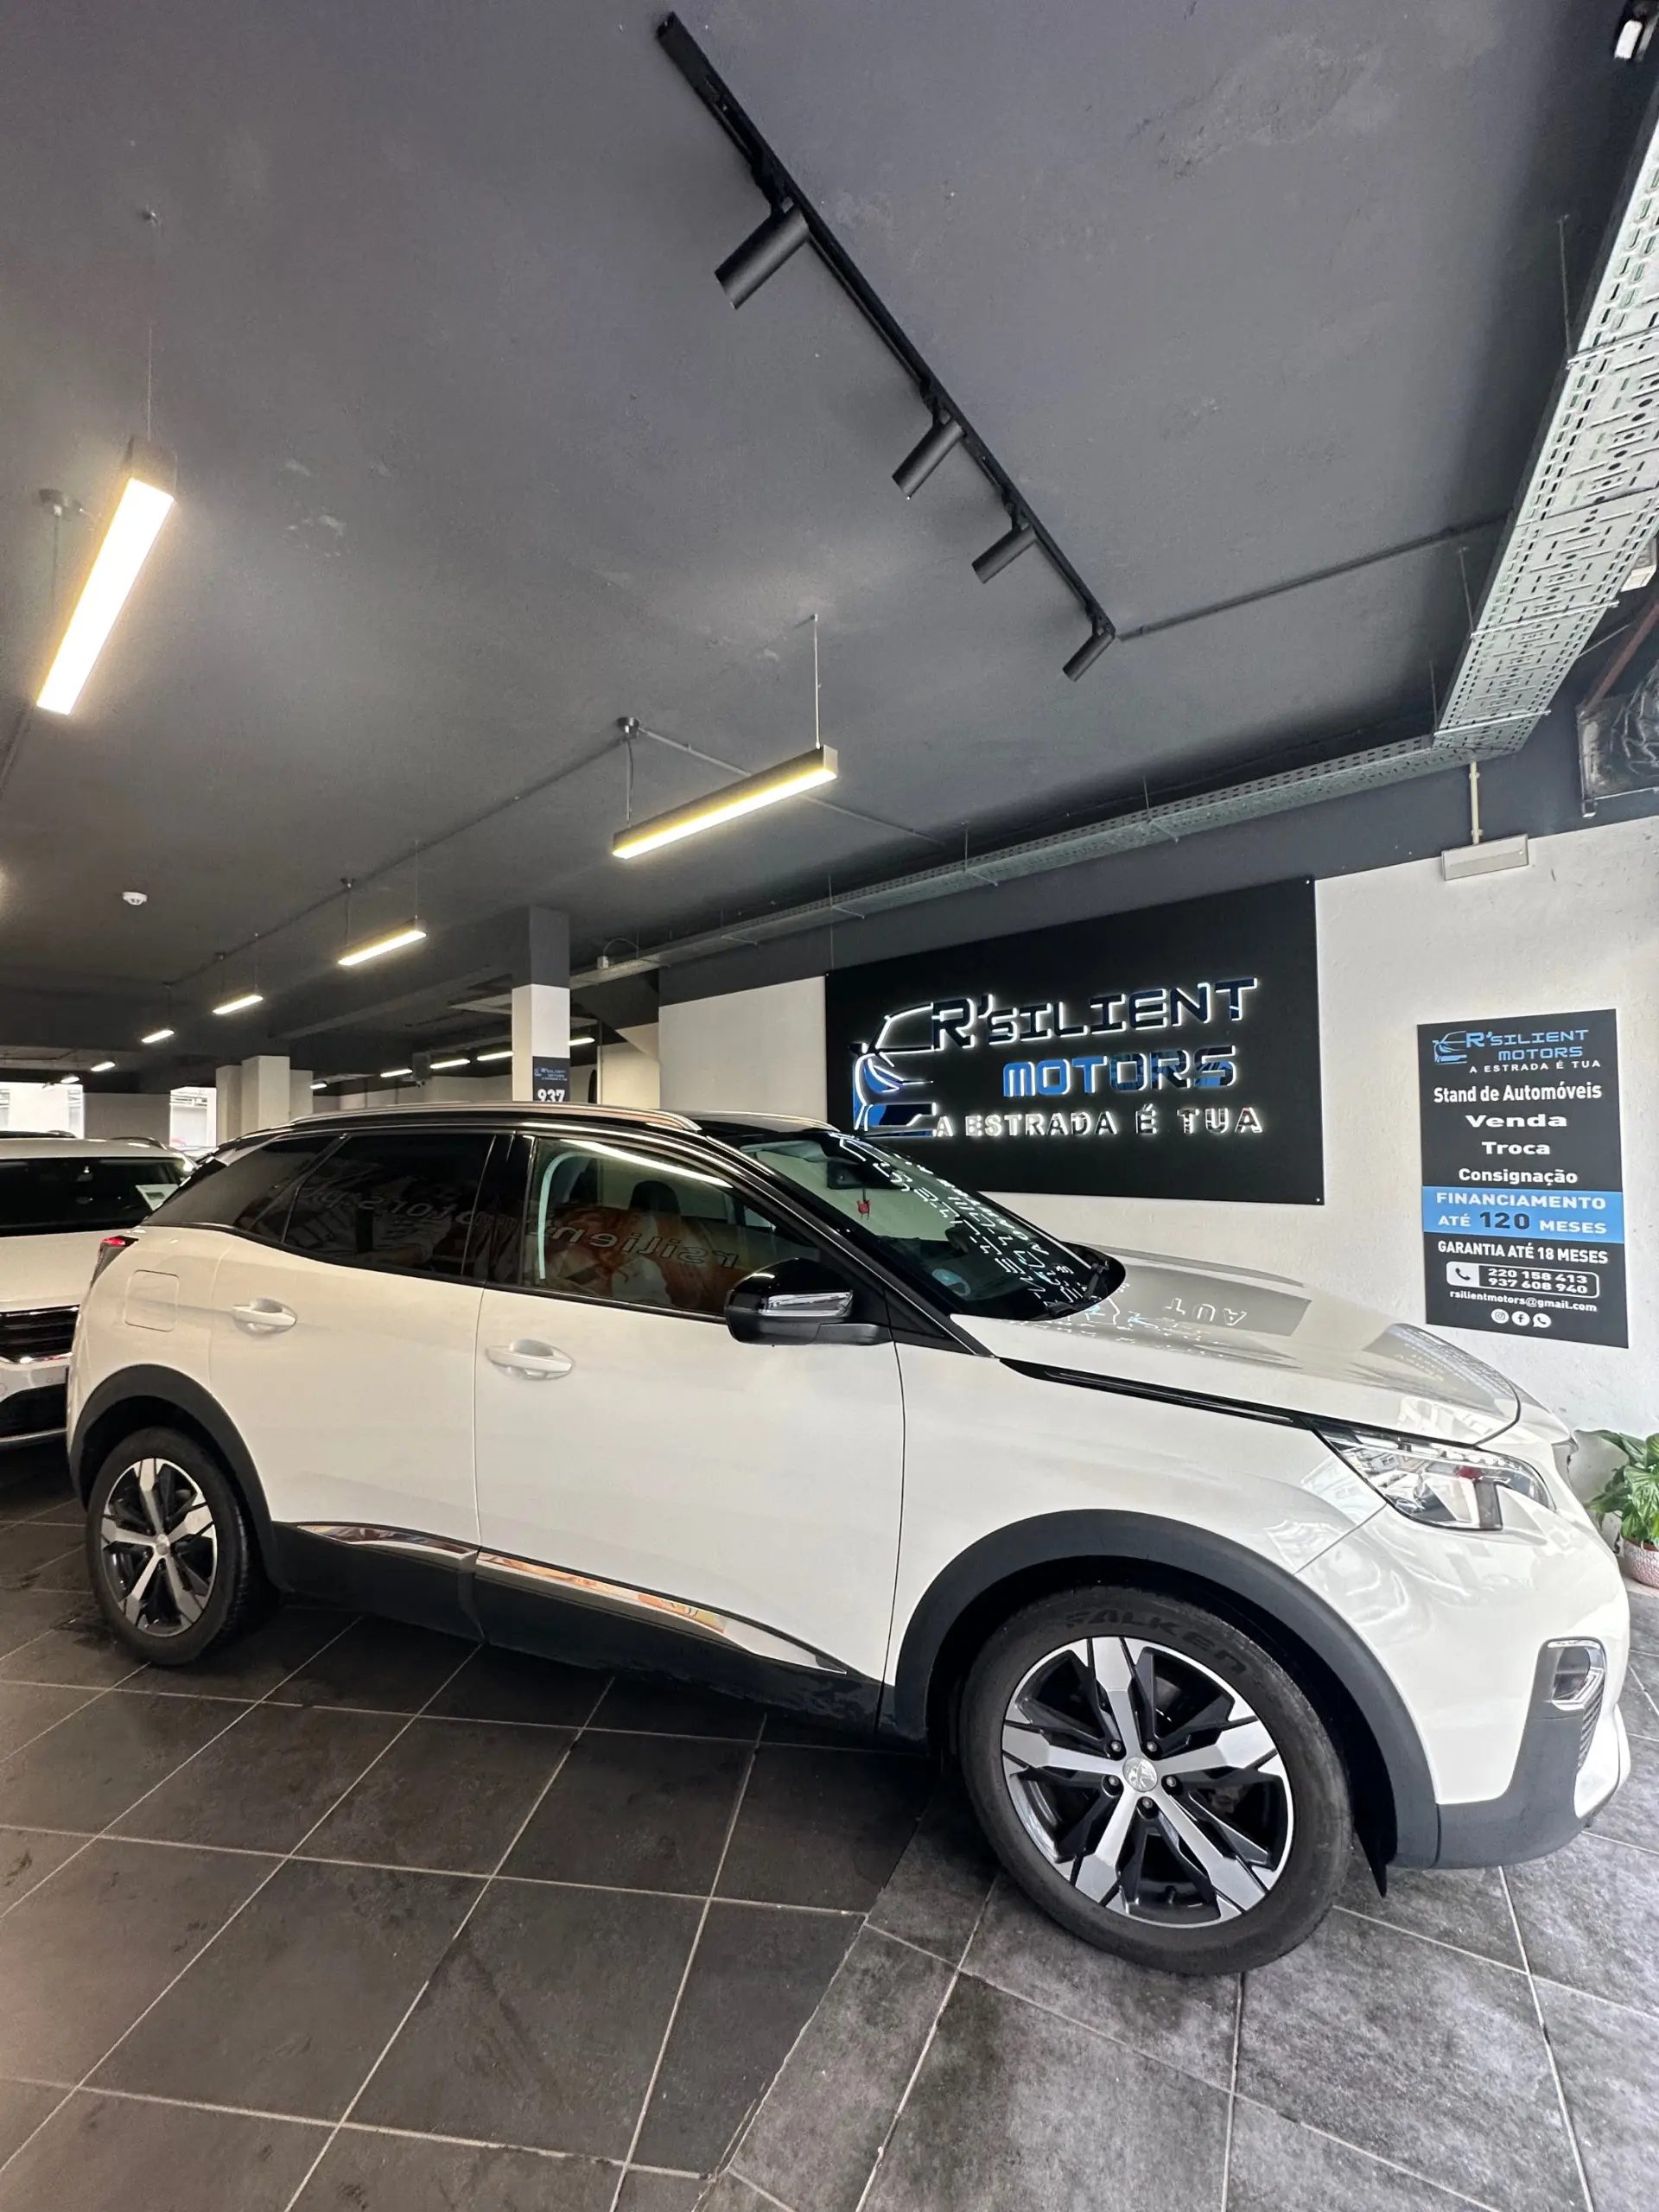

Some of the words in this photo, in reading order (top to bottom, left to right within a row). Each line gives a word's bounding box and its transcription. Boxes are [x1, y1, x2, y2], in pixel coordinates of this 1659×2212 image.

[1498, 1046, 1583, 1061] MOTORS
[1002, 1046, 1236, 1097] MOTORS
[1484, 1063, 1548, 1072] ESTRADA
[1556, 1060, 1564, 1070] É
[1433, 1085, 1477, 1103] Stand
[1480, 1086, 1499, 1102] de
[1503, 1082, 1602, 1101] Automóveis
[933, 1116, 955, 1137] A
[965, 1110, 1118, 1137] ESTRADA
[1135, 1103, 1157, 1135] É
[1177, 1107, 1263, 1135] TUA
[1465, 1114, 1567, 1128] Venda
[1482, 1141, 1551, 1154] Troca
[1459, 1168, 1578, 1185] Consignação
[1436, 1192, 1605, 1209] FINANCIAMENTO
[1438, 1213, 1471, 1227] ATÉ
[1479, 1211, 1530, 1230] 120
[1539, 1219, 1607, 1234] MESES
[1438, 1240, 1505, 1257] GARANTIA
[1508, 1243, 1534, 1259] ATÉ
[1537, 1247, 1554, 1261] 18
[1557, 1249, 1608, 1264] MESES
[1488, 1268, 1517, 1278] 220
[1522, 1271, 1552, 1281] 158
[1555, 1274, 1587, 1284] 413
[1488, 1278, 1516, 1287] 937
[1521, 1281, 1552, 1291] 608
[1555, 1284, 1587, 1294] 940
[1450, 1290, 1597, 1312] rsilientmotors@gmail.com
